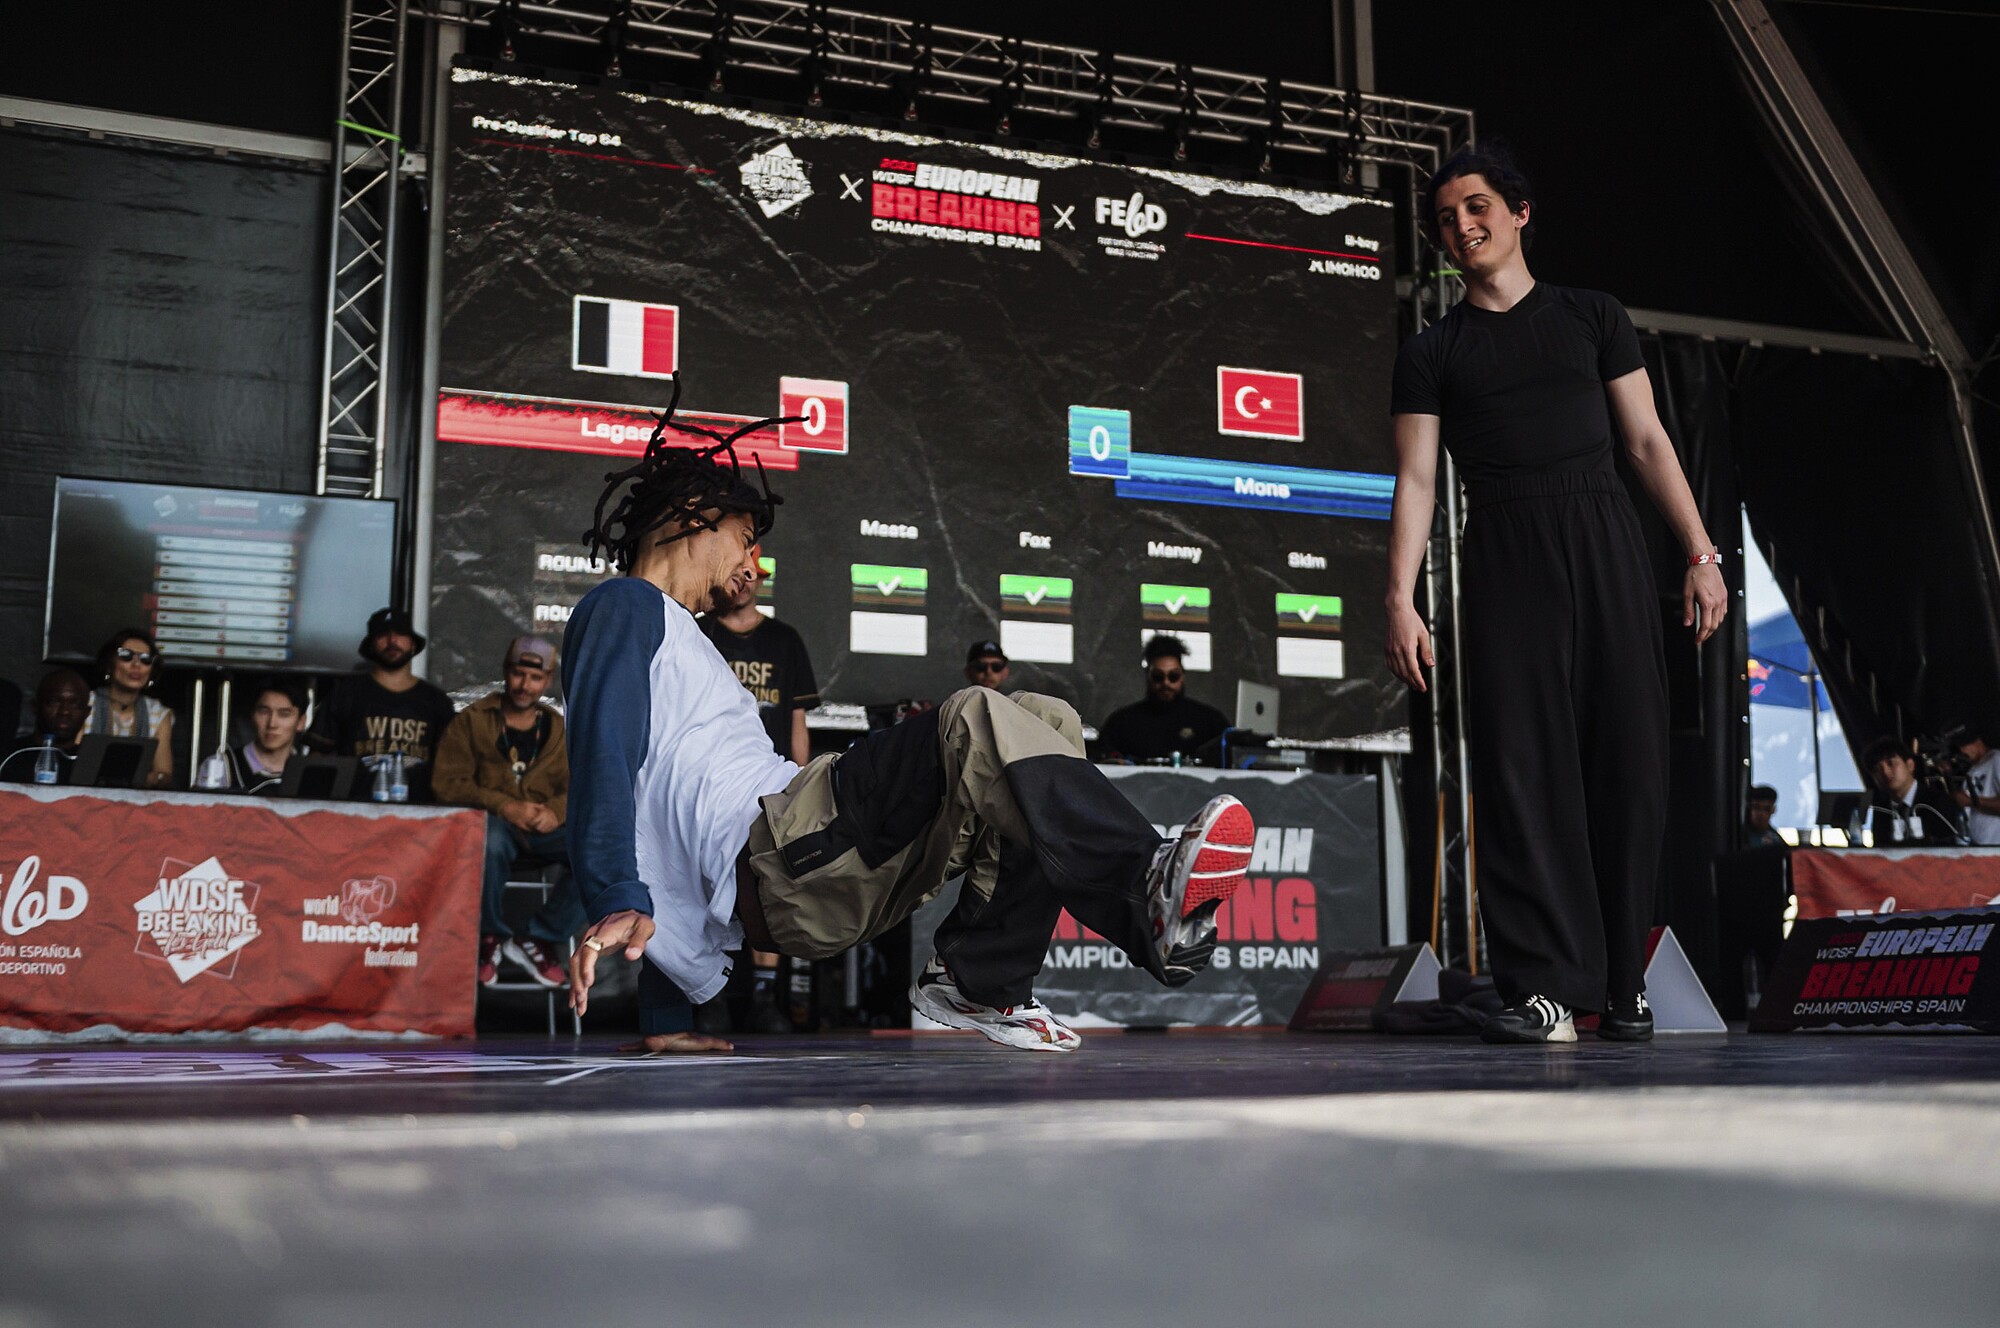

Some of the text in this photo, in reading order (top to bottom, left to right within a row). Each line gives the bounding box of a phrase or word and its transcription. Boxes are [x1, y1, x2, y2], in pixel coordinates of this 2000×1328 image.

[568, 129, 598, 146] Top
[752, 153, 803, 180] WDSF
[872, 163, 1041, 203] WDSF EUROPEAN
[872, 183, 1041, 238] BREAKING
[871, 218, 1041, 251] CHAMPIONSHIPS SPAIN
[801, 397, 827, 436] 0
[1088, 425, 1112, 462] 0
[1019, 531, 1052, 549] Fox
[539, 554, 605, 575] ROUND
[731, 661, 773, 686] DSF
[366, 716, 427, 742] WDSF
[160, 878, 245, 913] WDSF
[303, 895, 340, 916] world
[137, 911, 258, 934] BREAKING
[302, 920, 420, 948] DanceSport
[19, 944, 82, 959] ESPAÑOLA
[1816, 946, 1856, 960] WDSF
[1855, 924, 1995, 958] EUROPEAN
[0, 962, 66, 976] DEPORTIVO
[364, 947, 419, 968] federation
[1239, 945, 1319, 969] SPAIN
[1800, 956, 1981, 999] BREAKING
[1793, 999, 1967, 1016] CHAMPIONSHIPS SPAIN
